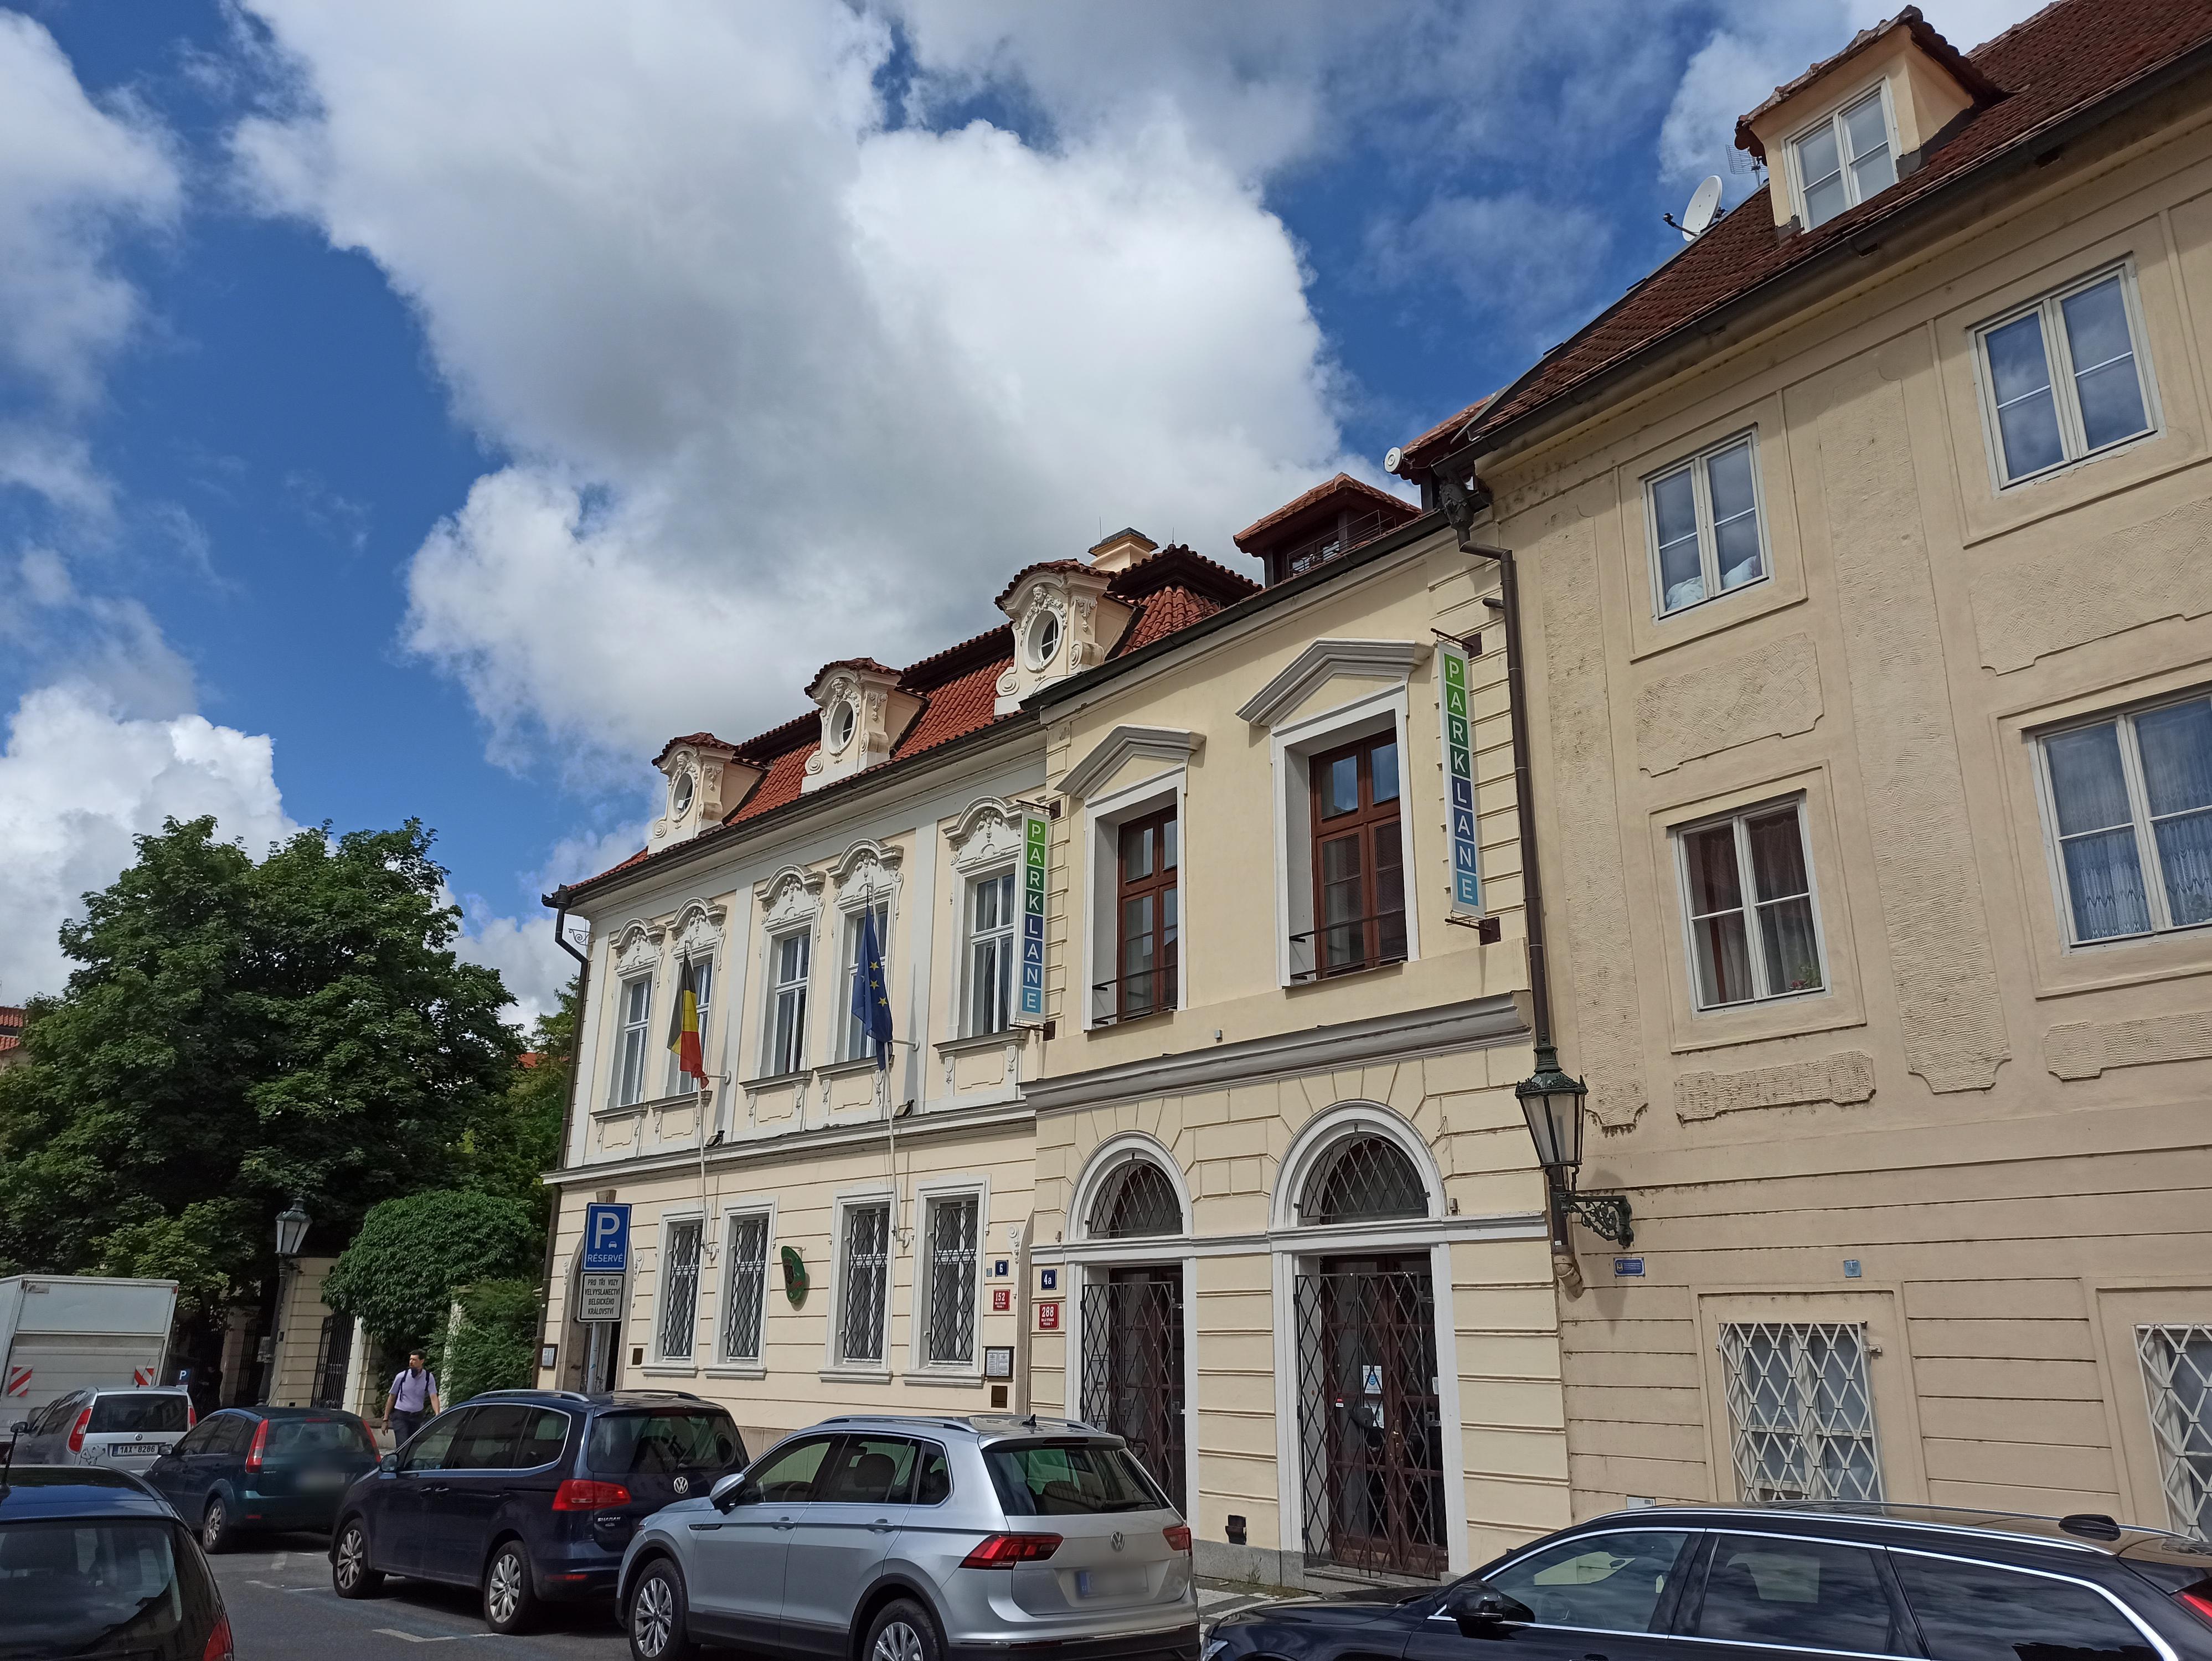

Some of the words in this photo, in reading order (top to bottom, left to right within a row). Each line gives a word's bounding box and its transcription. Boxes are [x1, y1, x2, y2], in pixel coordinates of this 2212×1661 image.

[594, 1212, 620, 1249] P
[587, 1252, 623, 1262] RÉSERVÉ
[999, 1263, 1003, 1273] 6
[1044, 1274, 1052, 1285] 4a
[585, 1287, 621, 1296] VELVYSLANECTVÍ
[588, 1297, 615, 1306] BELGICKÉHO
[996, 1292, 1006, 1302] 152
[587, 1307, 614, 1315] KRÁLOVSTVÍ
[1041, 1307, 1054, 1318] 288
[179, 1370, 187, 1380] P
